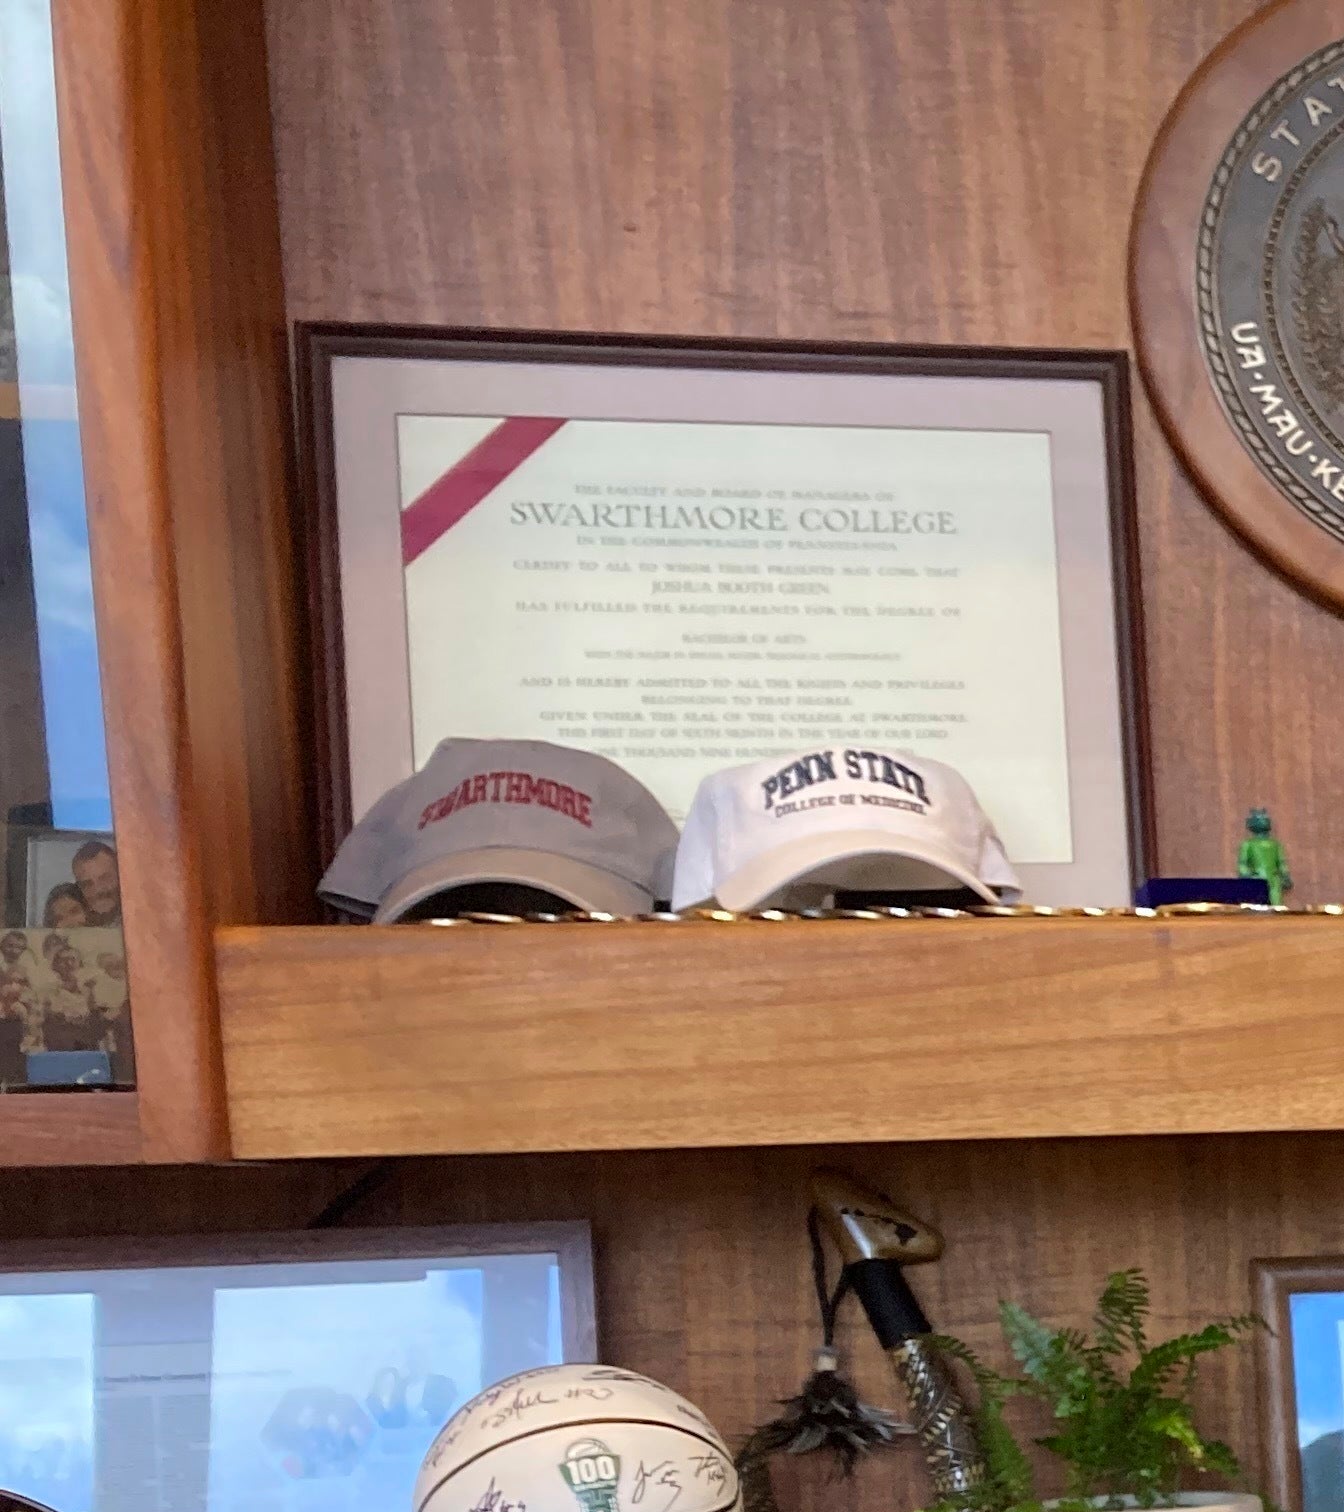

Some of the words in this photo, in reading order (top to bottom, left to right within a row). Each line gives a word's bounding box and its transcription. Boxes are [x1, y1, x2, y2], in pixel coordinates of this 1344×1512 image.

[1231, 322, 1267, 369] UA
[1250, 384, 1314, 456] MAU
[510, 501, 789, 531] SWARTHMORE
[798, 507, 959, 535] COLLEGE
[417, 771, 592, 831] SWARTHMORE
[761, 751, 838, 810] PENN
[843, 750, 932, 806] STATE
[566, 1456, 617, 1485] 100
